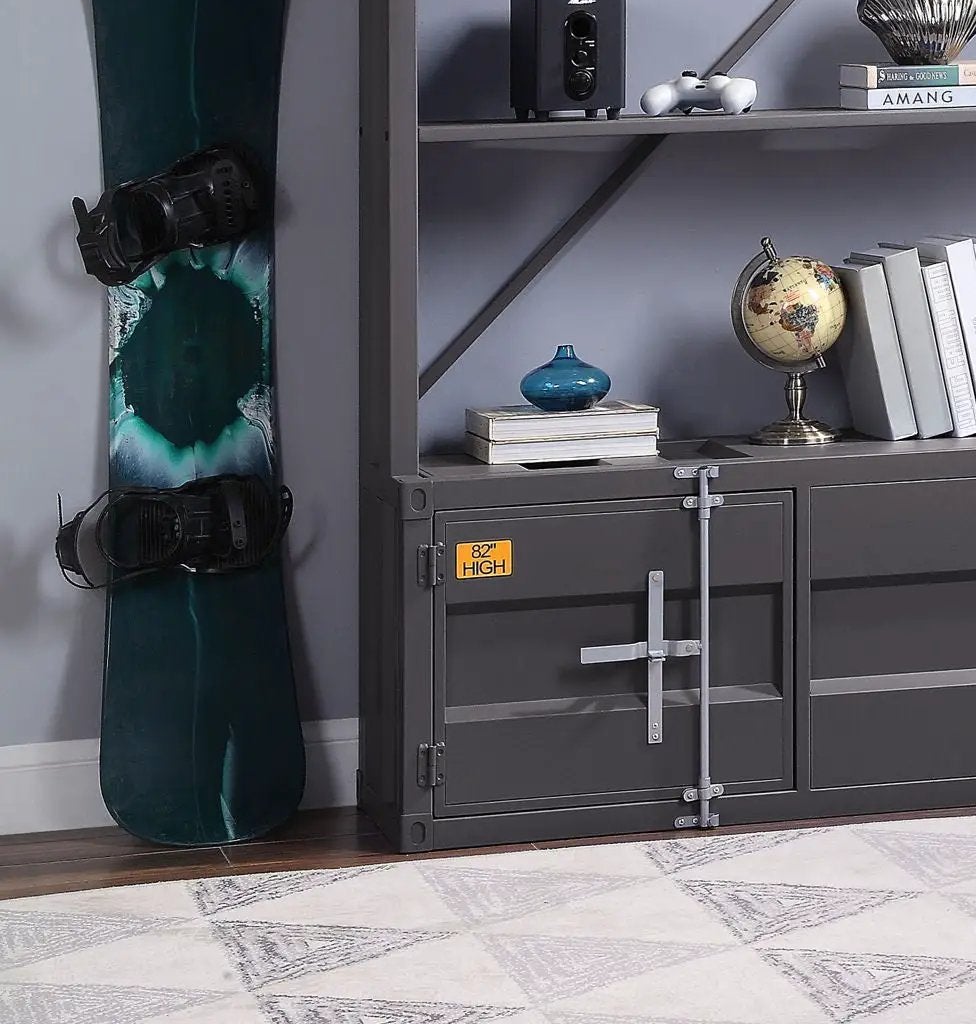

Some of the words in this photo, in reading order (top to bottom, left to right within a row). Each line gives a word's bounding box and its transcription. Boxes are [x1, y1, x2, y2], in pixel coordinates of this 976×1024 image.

[882, 90, 953, 106] AMANG
[471, 543, 497, 558] 82"
[463, 559, 506, 576] HIGH
